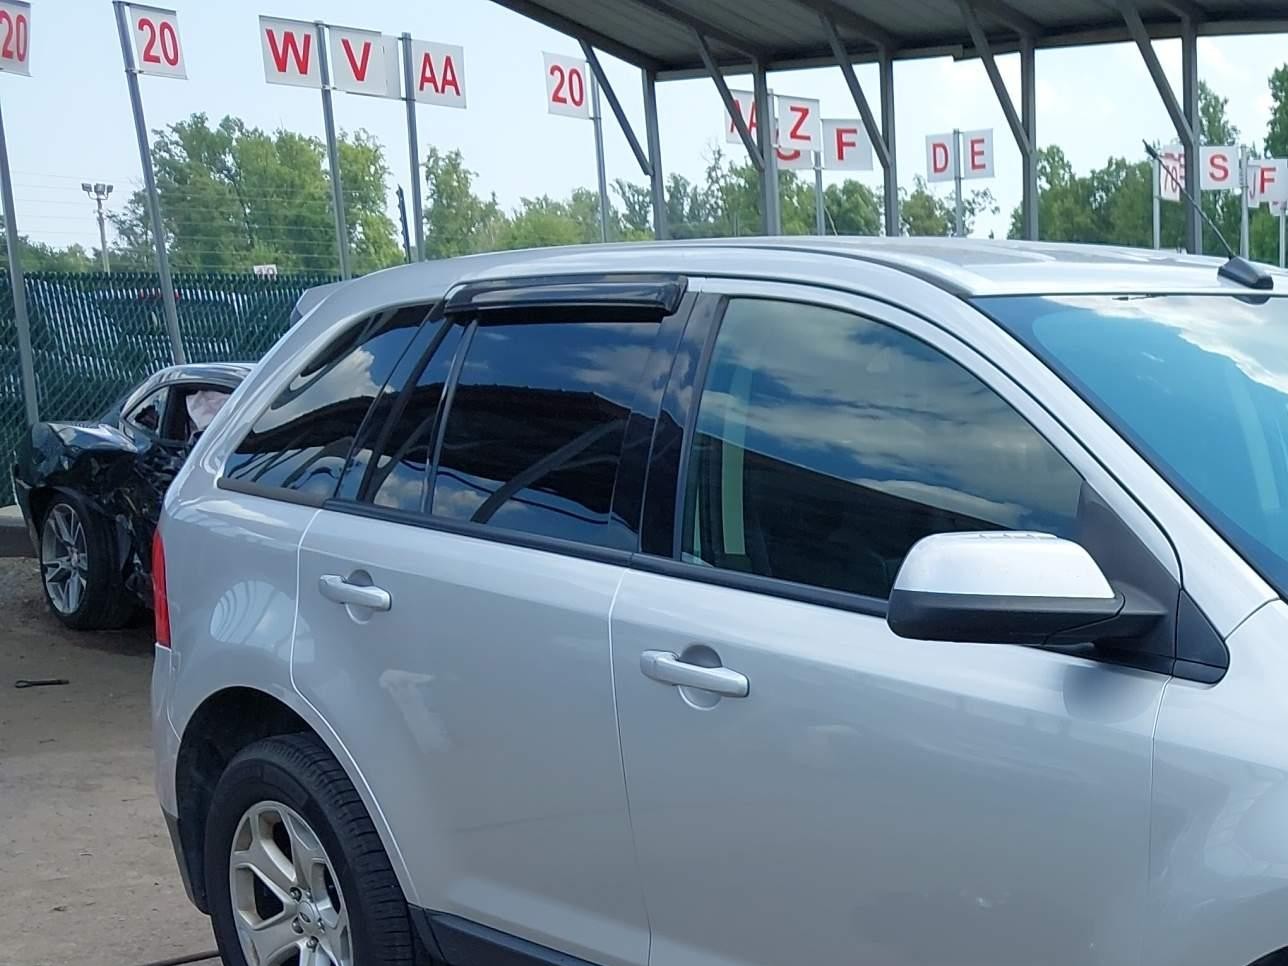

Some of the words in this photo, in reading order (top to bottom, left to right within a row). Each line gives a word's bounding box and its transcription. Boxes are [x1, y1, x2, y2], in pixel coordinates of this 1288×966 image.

[0, 10, 27, 62] 20
[138, 18, 180, 67] 20
[266, 29, 312, 76] W
[342, 39, 372, 82] V
[419, 53, 460, 95] AA
[549, 64, 585, 107] 20
[789, 105, 811, 141] Z
[836, 127, 858, 161] F
[932, 143, 949, 173] D
[970, 138, 986, 170] E
[1209, 154, 1229, 181] S
[1259, 166, 1277, 193] F
